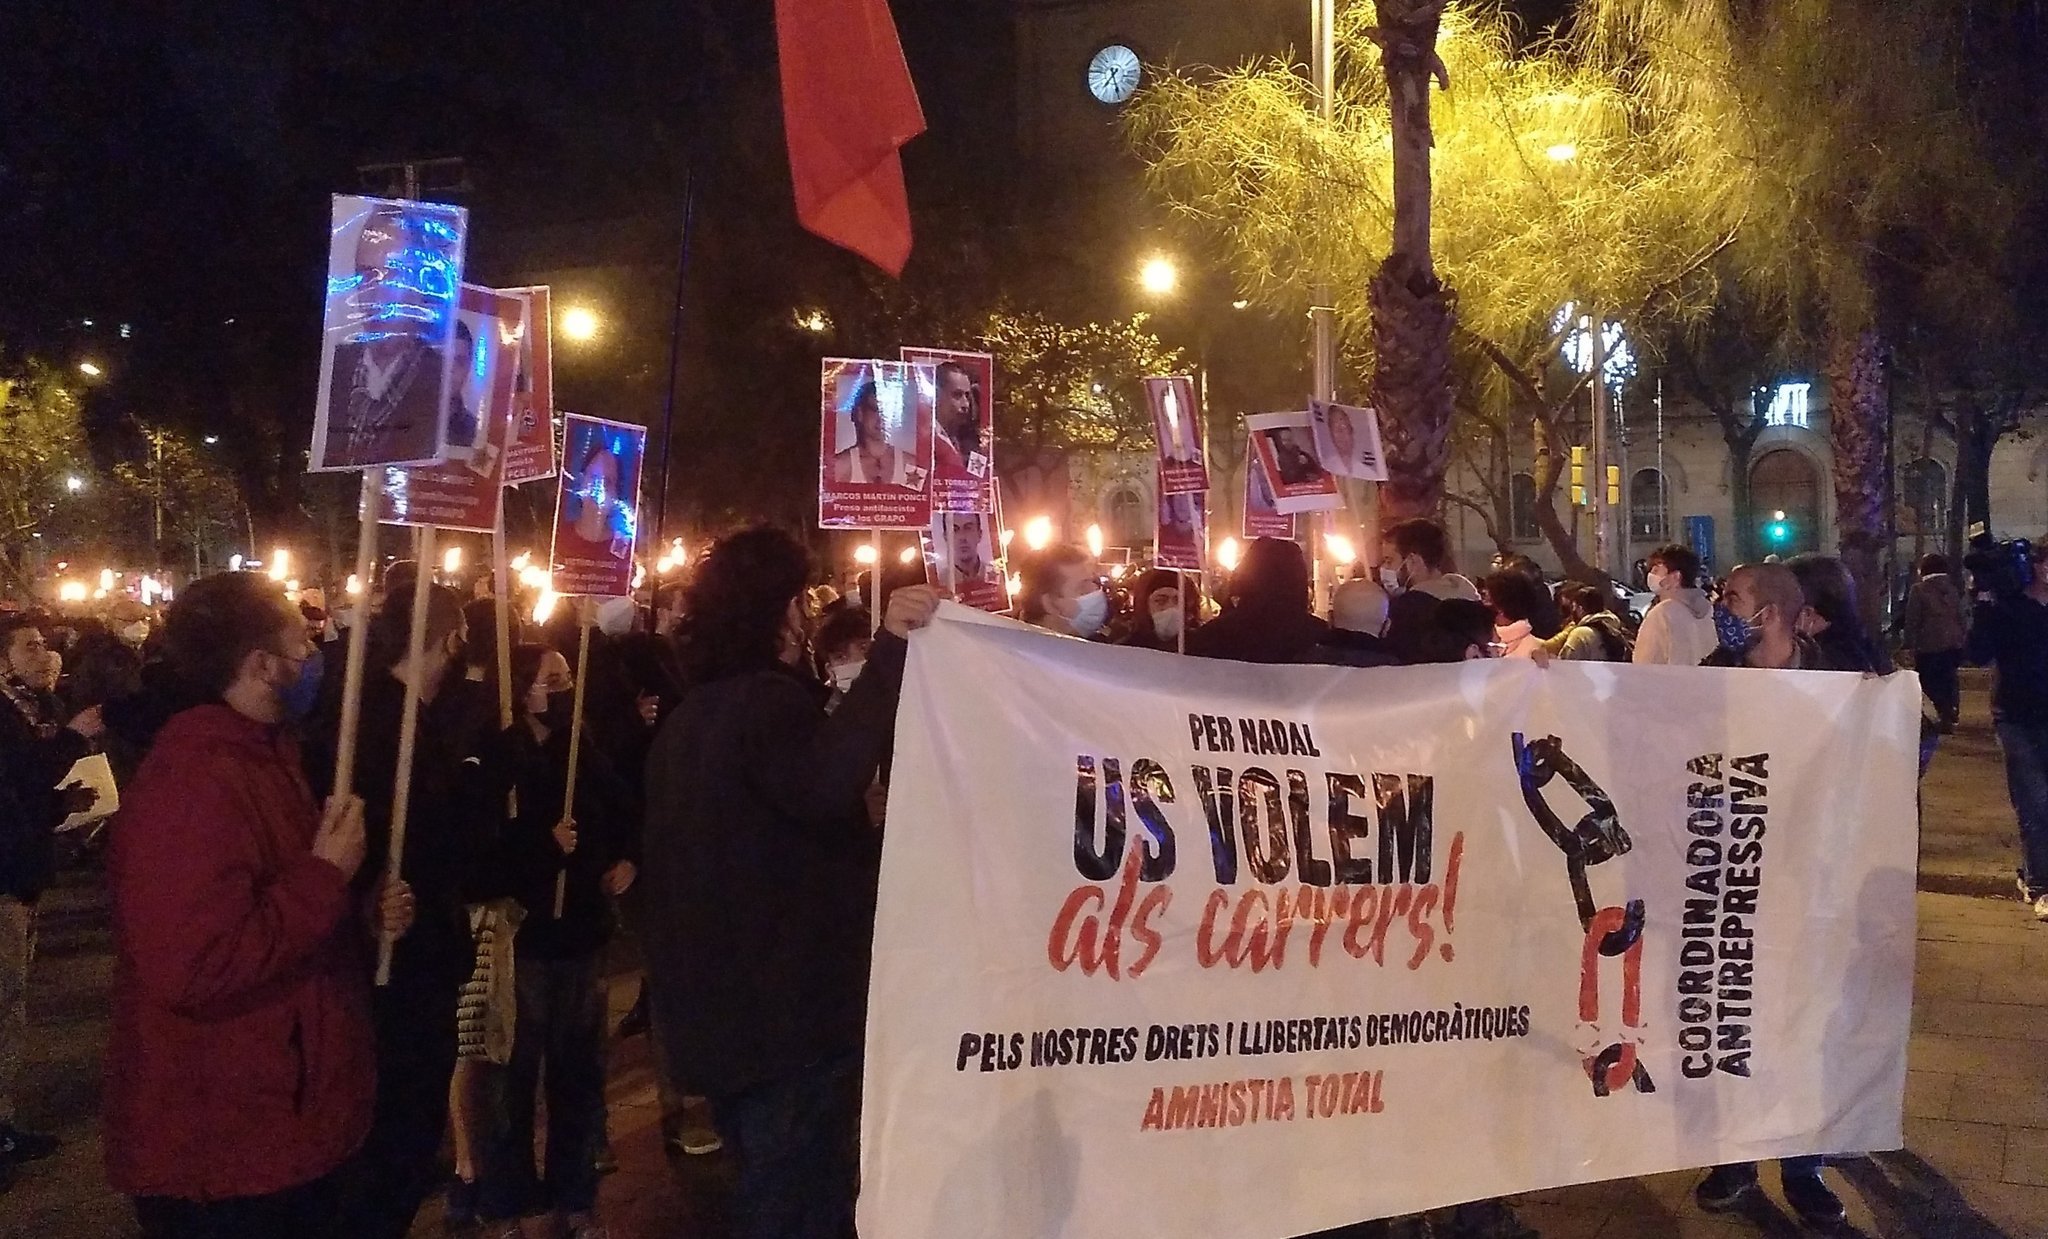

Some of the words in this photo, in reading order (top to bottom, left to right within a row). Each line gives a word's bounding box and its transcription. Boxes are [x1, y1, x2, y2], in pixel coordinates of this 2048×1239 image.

[833, 503, 861, 511] Preso
[873, 514, 906, 522] GRAPO
[1188, 713, 1235, 752] PER
[1239, 718, 1320, 757] NADAL
[1073, 755, 1176, 882] US
[1190, 764, 1434, 887] VOLEM
[1047, 834, 1173, 982] als
[1196, 831, 1465, 973] carrers!
[1677, 752, 1725, 1079] COORDINADORA
[1716, 752, 1770, 1078] ANTIREPRESSIVA
[956, 1032, 1024, 1072] PELS
[1030, 1027, 1139, 1068] NOSTRES
[1145, 1023, 1219, 1062] DRETS
[1226, 1021, 1234, 1056] I
[1238, 1015, 1362, 1056] LLIBERTATS
[1366, 1002, 1530, 1047] DEMOCRÀTIQUES
[1141, 1077, 1296, 1132] AMNISTIA
[1305, 1070, 1385, 1119] TOTAL
